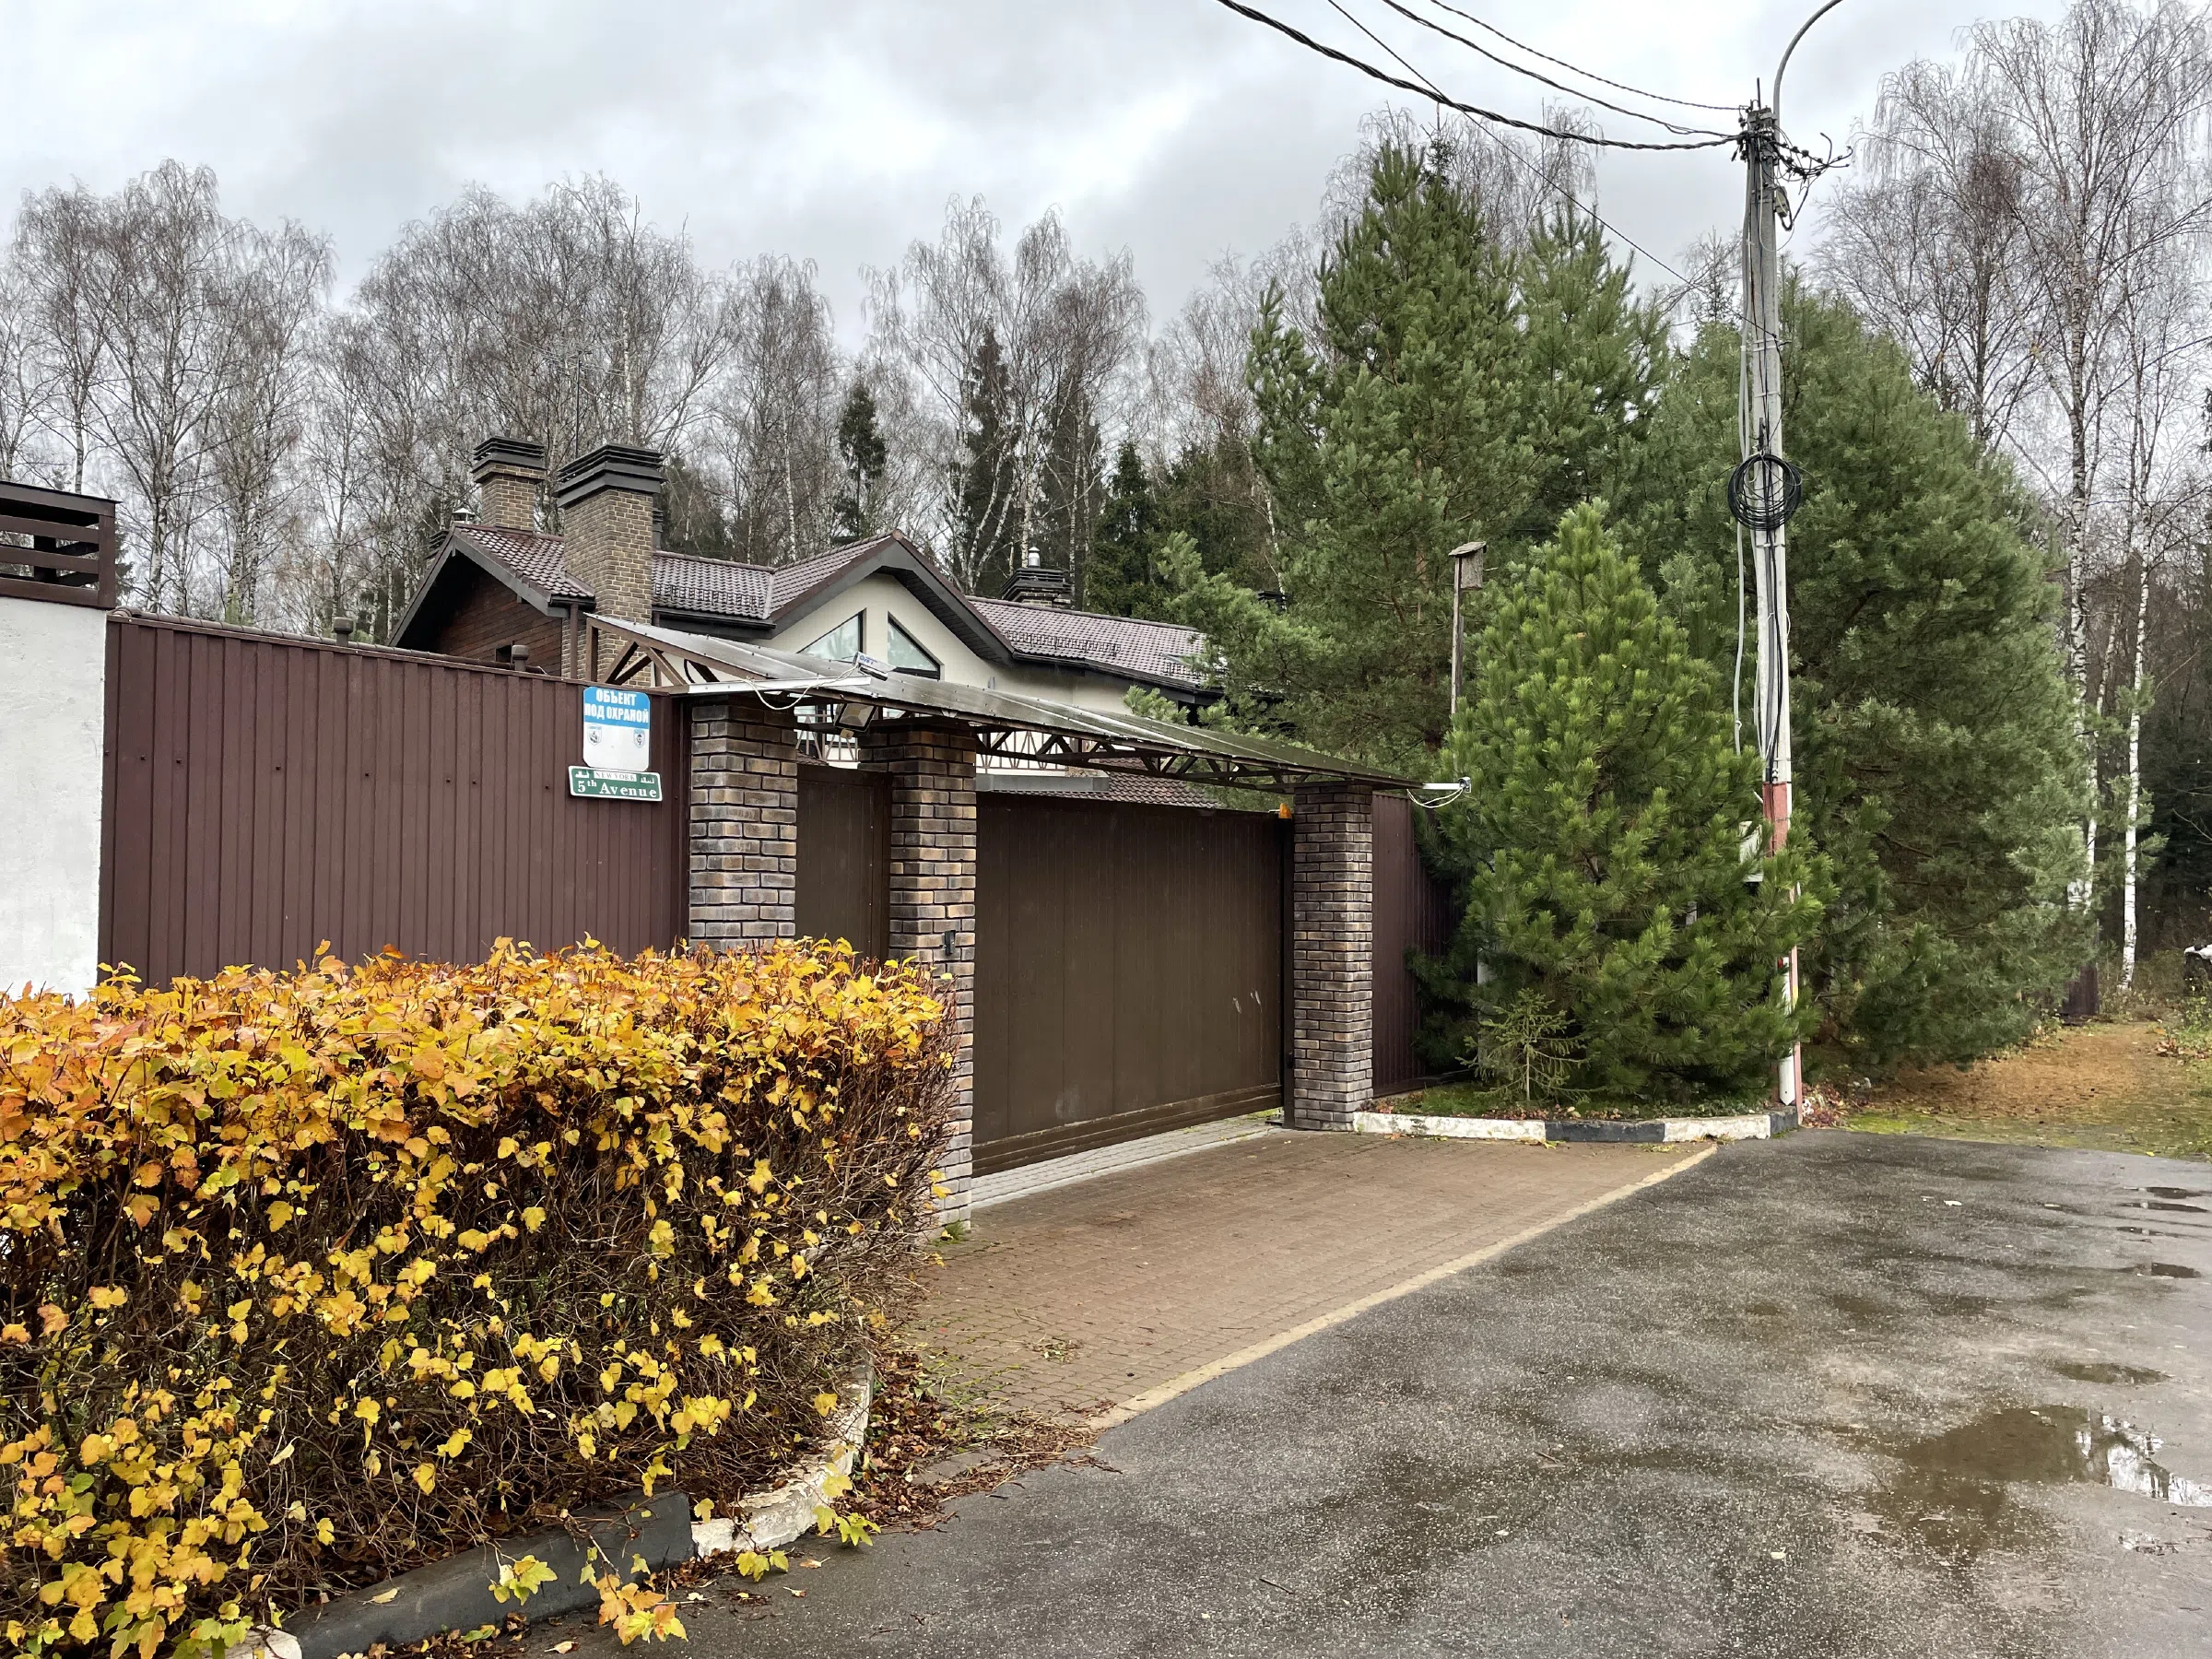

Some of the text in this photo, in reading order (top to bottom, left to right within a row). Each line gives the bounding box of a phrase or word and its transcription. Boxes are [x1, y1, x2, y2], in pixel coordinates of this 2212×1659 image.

[595, 689, 637, 706] ОБЪЕКТ
[583, 703, 649, 723] ПОД ОХРАНОЙ
[577, 780, 657, 797] 5th Avenue
